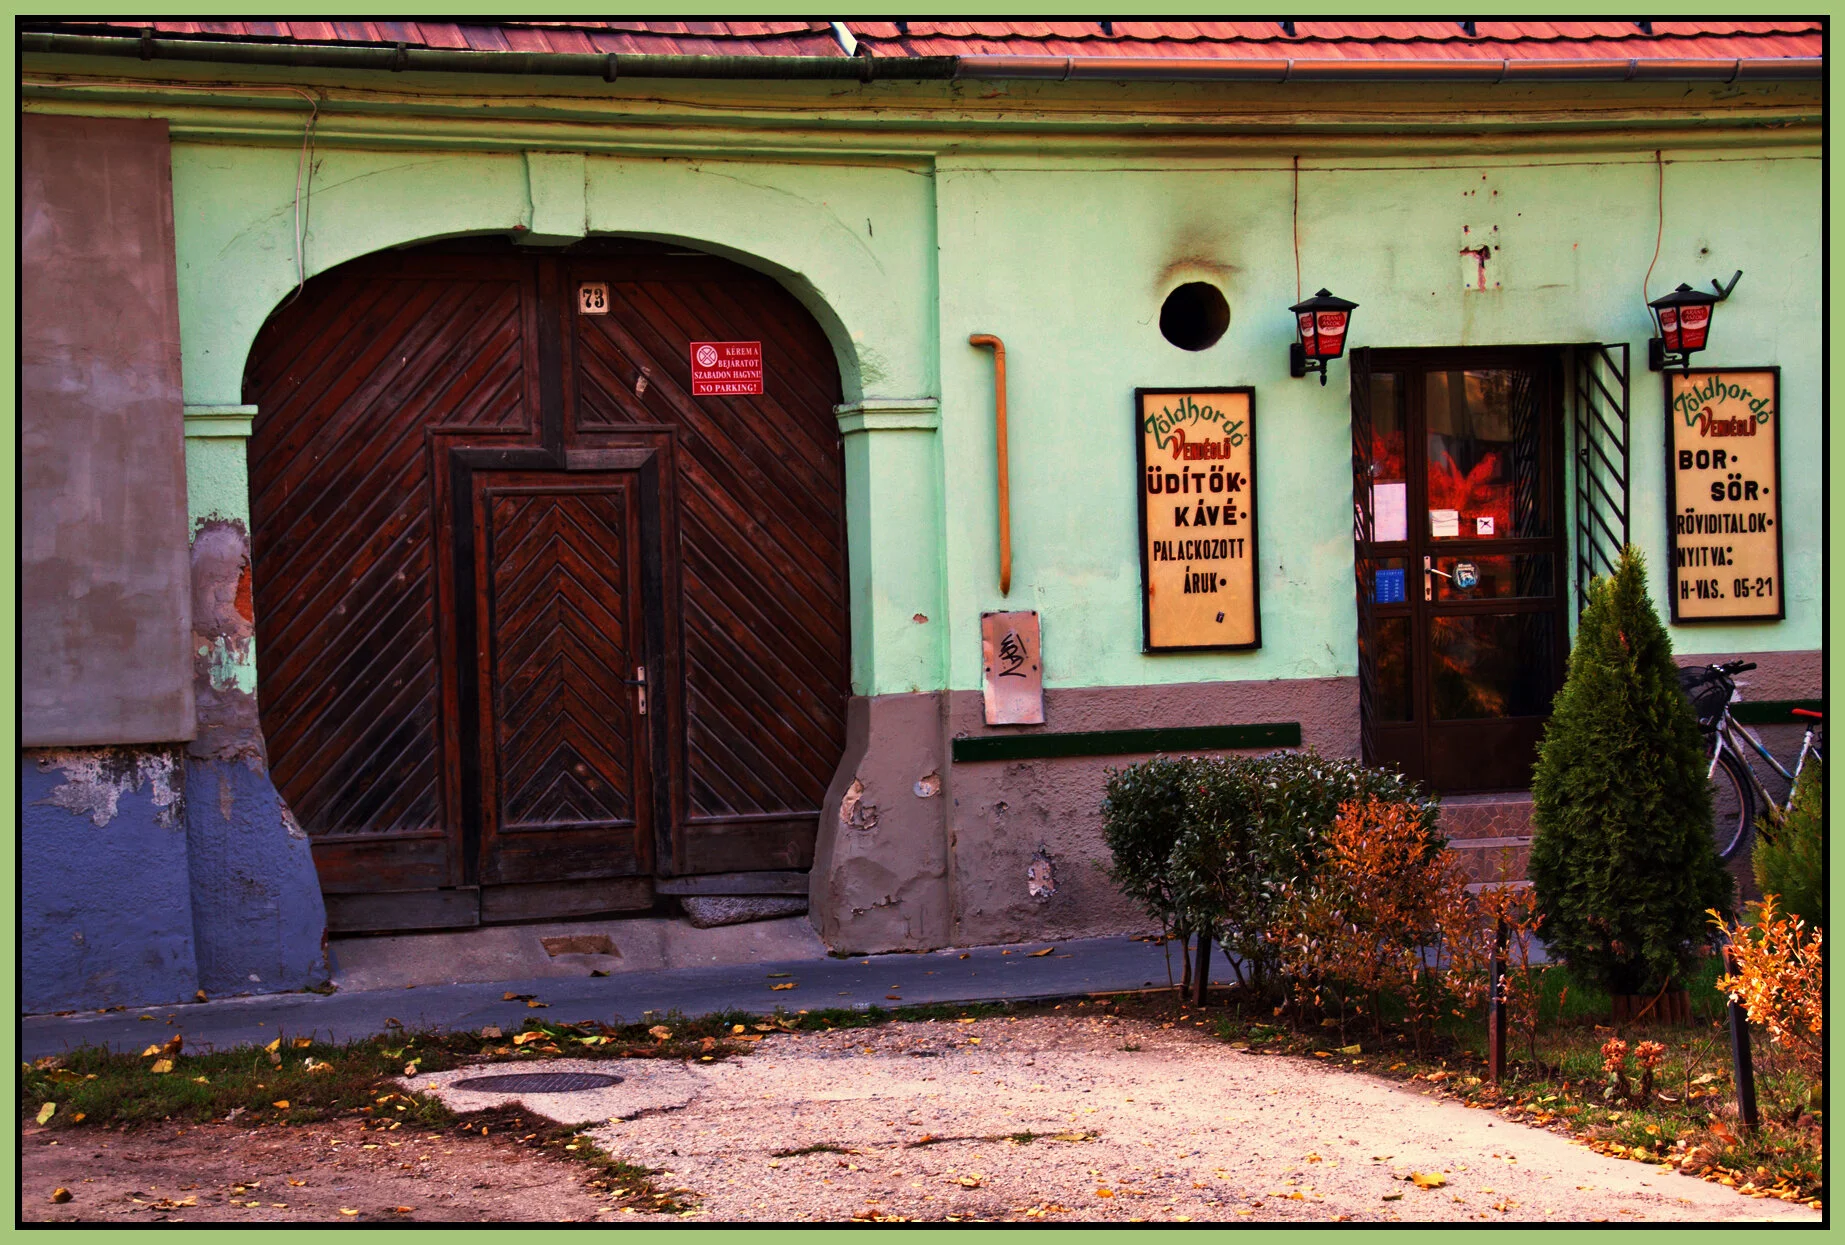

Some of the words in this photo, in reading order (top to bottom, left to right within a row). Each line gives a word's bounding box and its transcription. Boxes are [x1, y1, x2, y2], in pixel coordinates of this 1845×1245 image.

[582, 288, 605, 309] 73
[726, 345, 752, 356] KÉREM
[753, 347, 759, 356] A
[718, 358, 759, 370] BEJÁRATOT
[694, 371, 732, 380] SZABADON
[733, 370, 762, 379] HAGYNI!
[700, 384, 713, 393] NO
[715, 383, 757, 393] PARKING!
[1153, 538, 1245, 561] PALACKOZOTT
[1676, 546, 1733, 568] NYITVA:
[1680, 578, 1725, 599] H-VAS.
[1733, 577, 1773, 598] 05-21
